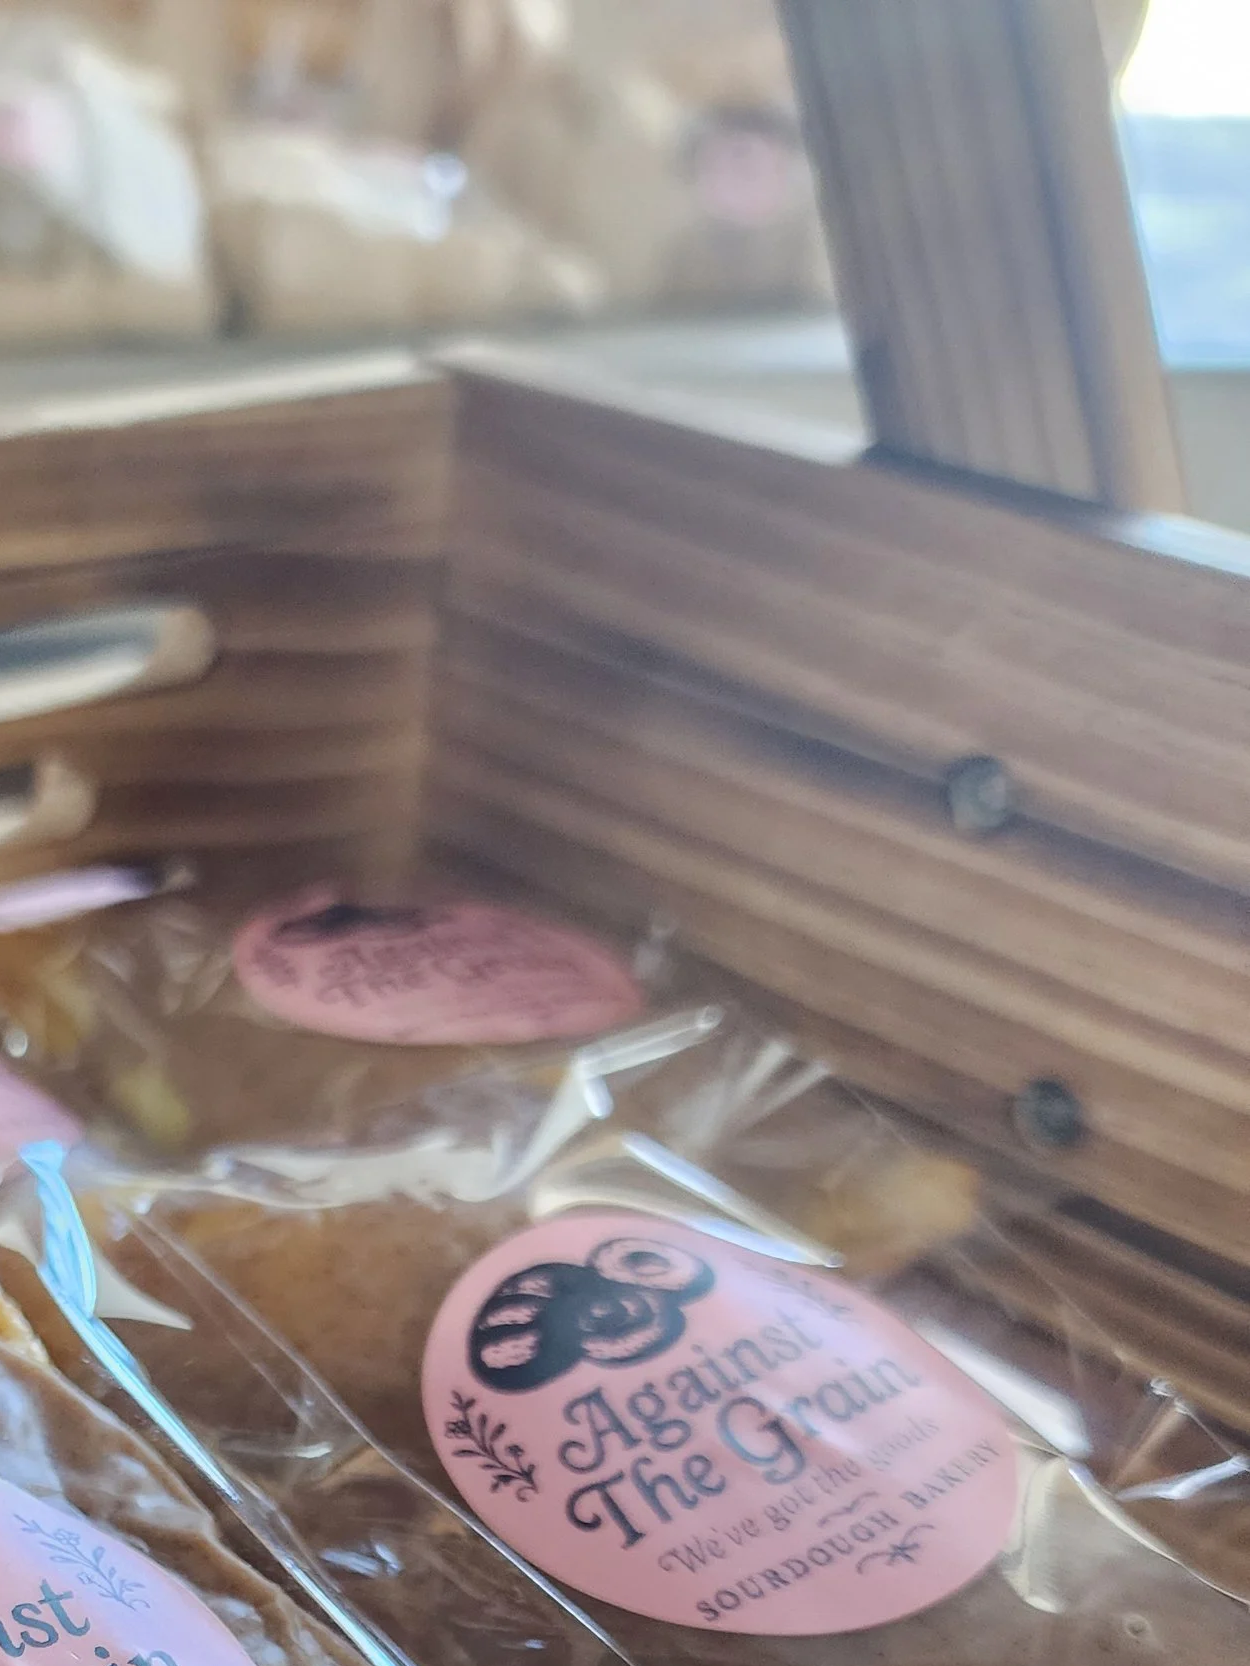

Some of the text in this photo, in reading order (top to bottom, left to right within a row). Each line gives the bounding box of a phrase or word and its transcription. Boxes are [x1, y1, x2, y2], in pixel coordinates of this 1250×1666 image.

[558, 1309, 823, 1473] Against
[565, 1356, 922, 1550] The Grain
[658, 1518, 761, 1577] We've
[763, 1486, 816, 1532] got
[810, 1459, 861, 1496] the
[696, 1437, 1001, 1622] SOURDOUGH BAKERY
